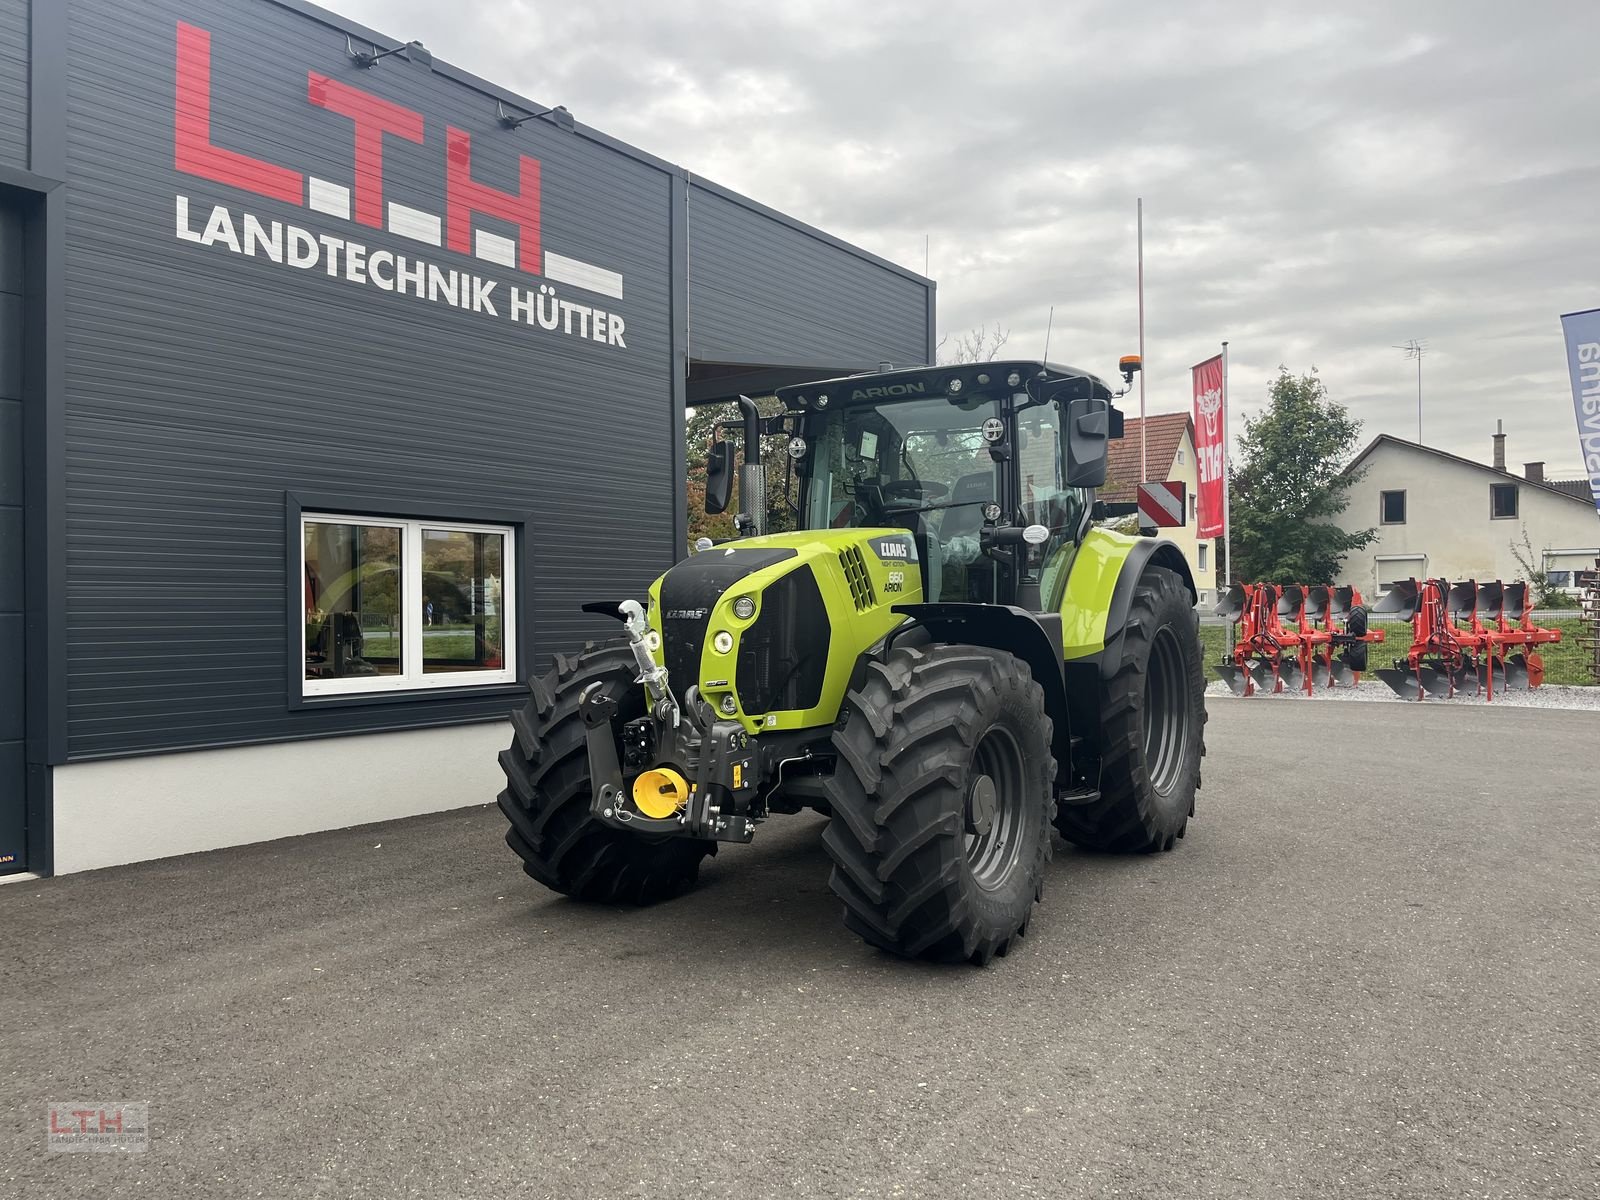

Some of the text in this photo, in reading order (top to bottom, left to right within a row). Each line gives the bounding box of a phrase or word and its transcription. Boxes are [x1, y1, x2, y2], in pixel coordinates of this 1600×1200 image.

[176, 195, 627, 349] LANDTECHNIK HÜTTER
[851, 382, 926, 400] ARION
[881, 543, 907, 557] CLAAS
[889, 572, 904, 583] 660
[884, 583, 902, 593] ARION
